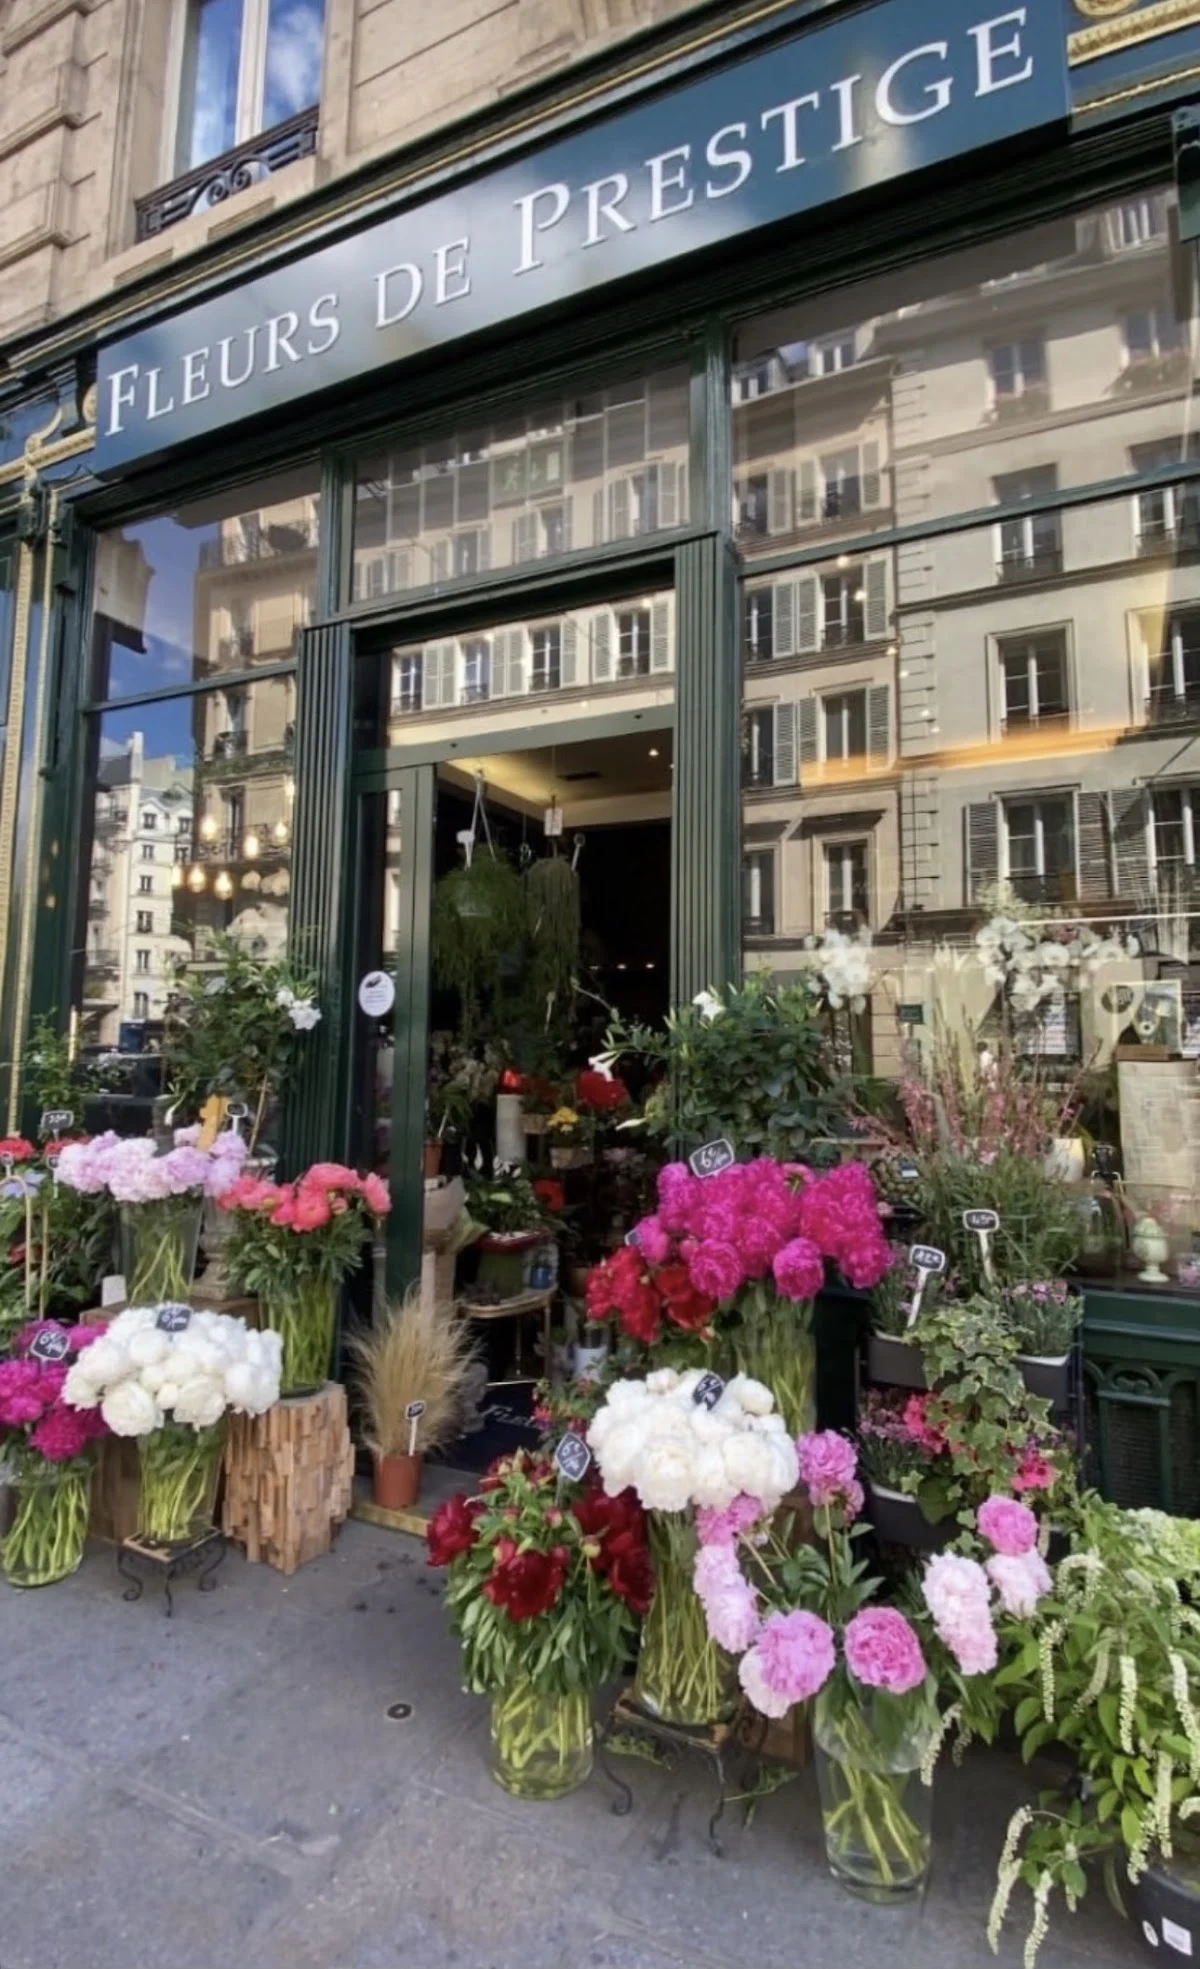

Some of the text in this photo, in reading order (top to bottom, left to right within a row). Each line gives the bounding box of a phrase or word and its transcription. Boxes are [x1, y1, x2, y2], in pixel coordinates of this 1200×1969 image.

[104, 7, 1034, 437] FLEURS DE PRESTIGE
